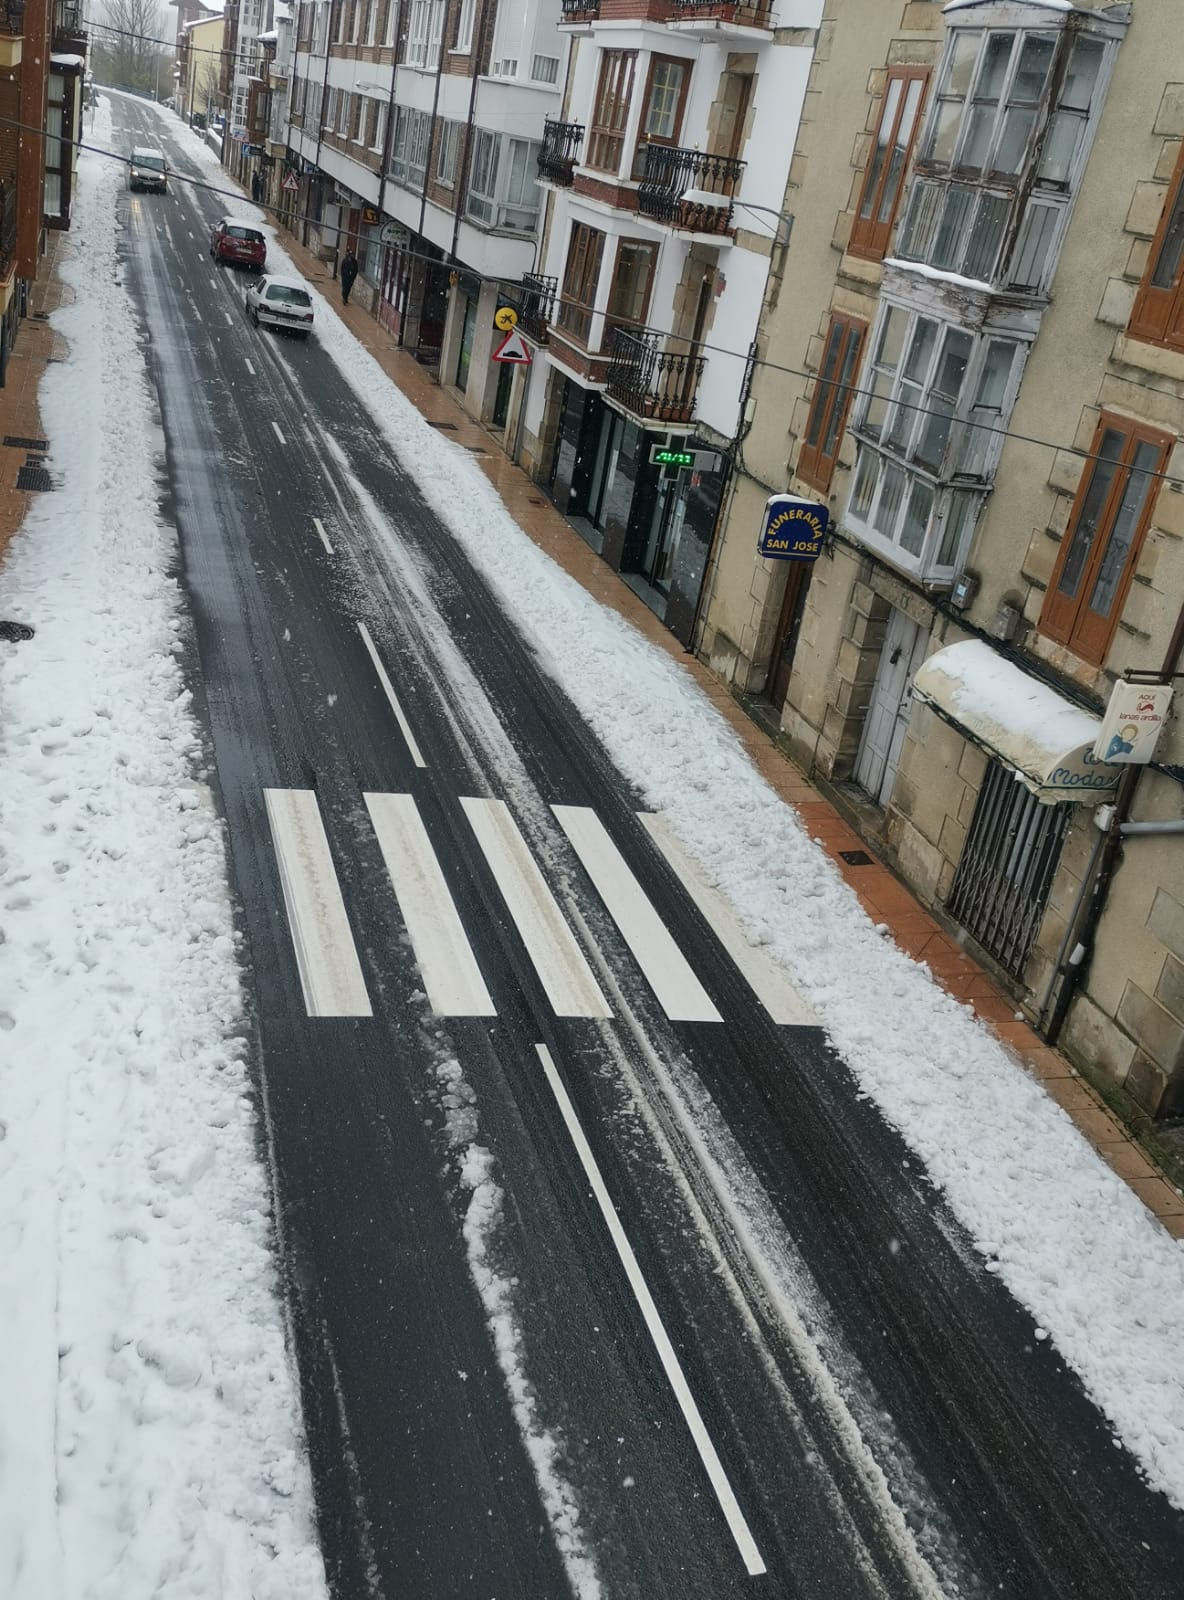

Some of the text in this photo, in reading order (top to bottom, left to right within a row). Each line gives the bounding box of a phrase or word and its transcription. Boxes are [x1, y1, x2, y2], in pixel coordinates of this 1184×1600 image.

[768, 509, 823, 539] FUNERARIA
[767, 540, 818, 551] SAN JOSE
